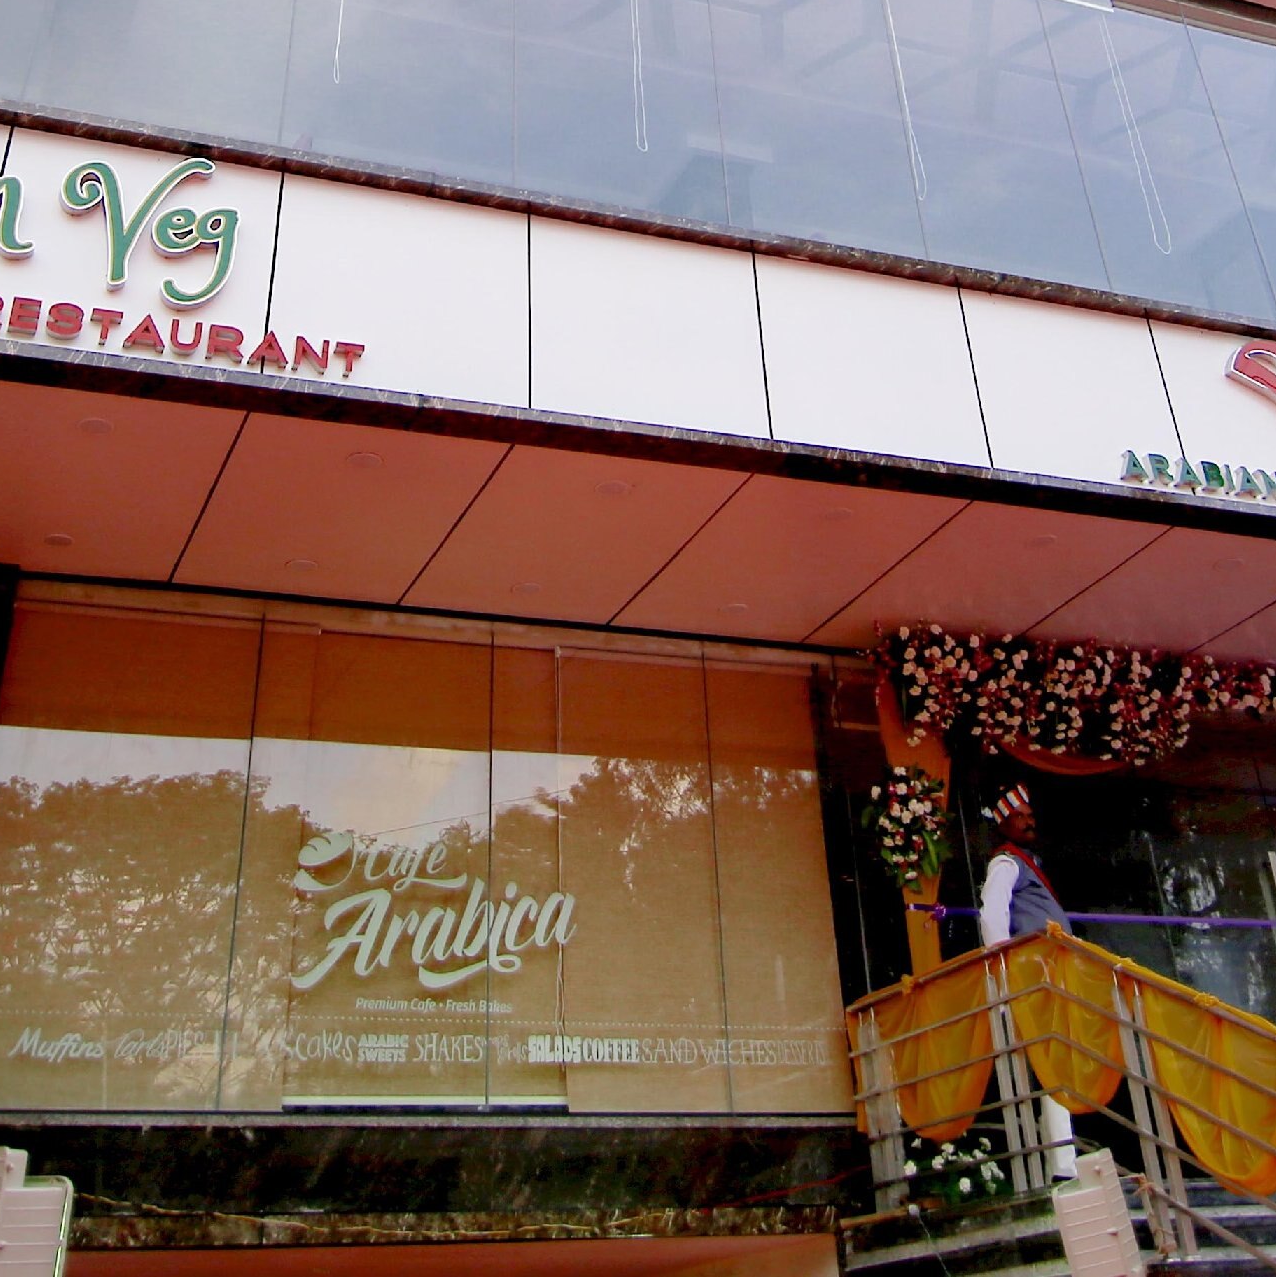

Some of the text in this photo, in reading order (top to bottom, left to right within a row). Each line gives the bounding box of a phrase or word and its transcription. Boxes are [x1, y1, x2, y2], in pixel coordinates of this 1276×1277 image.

[59, 156, 242, 311] Veg
[291, 876, 577, 989] Arabica
[355, 997, 514, 1013] Premium Cafe Fresh Bakes
[8, 1027, 106, 1064] Muffins
[358, 1034, 410, 1048] ARABIC
[412, 1032, 483, 1062] SHAKES
[528, 1034, 582, 1063] SALADS
[582, 1037, 640, 1062] COFFEE
[357, 1048, 407, 1062] SWEETS
